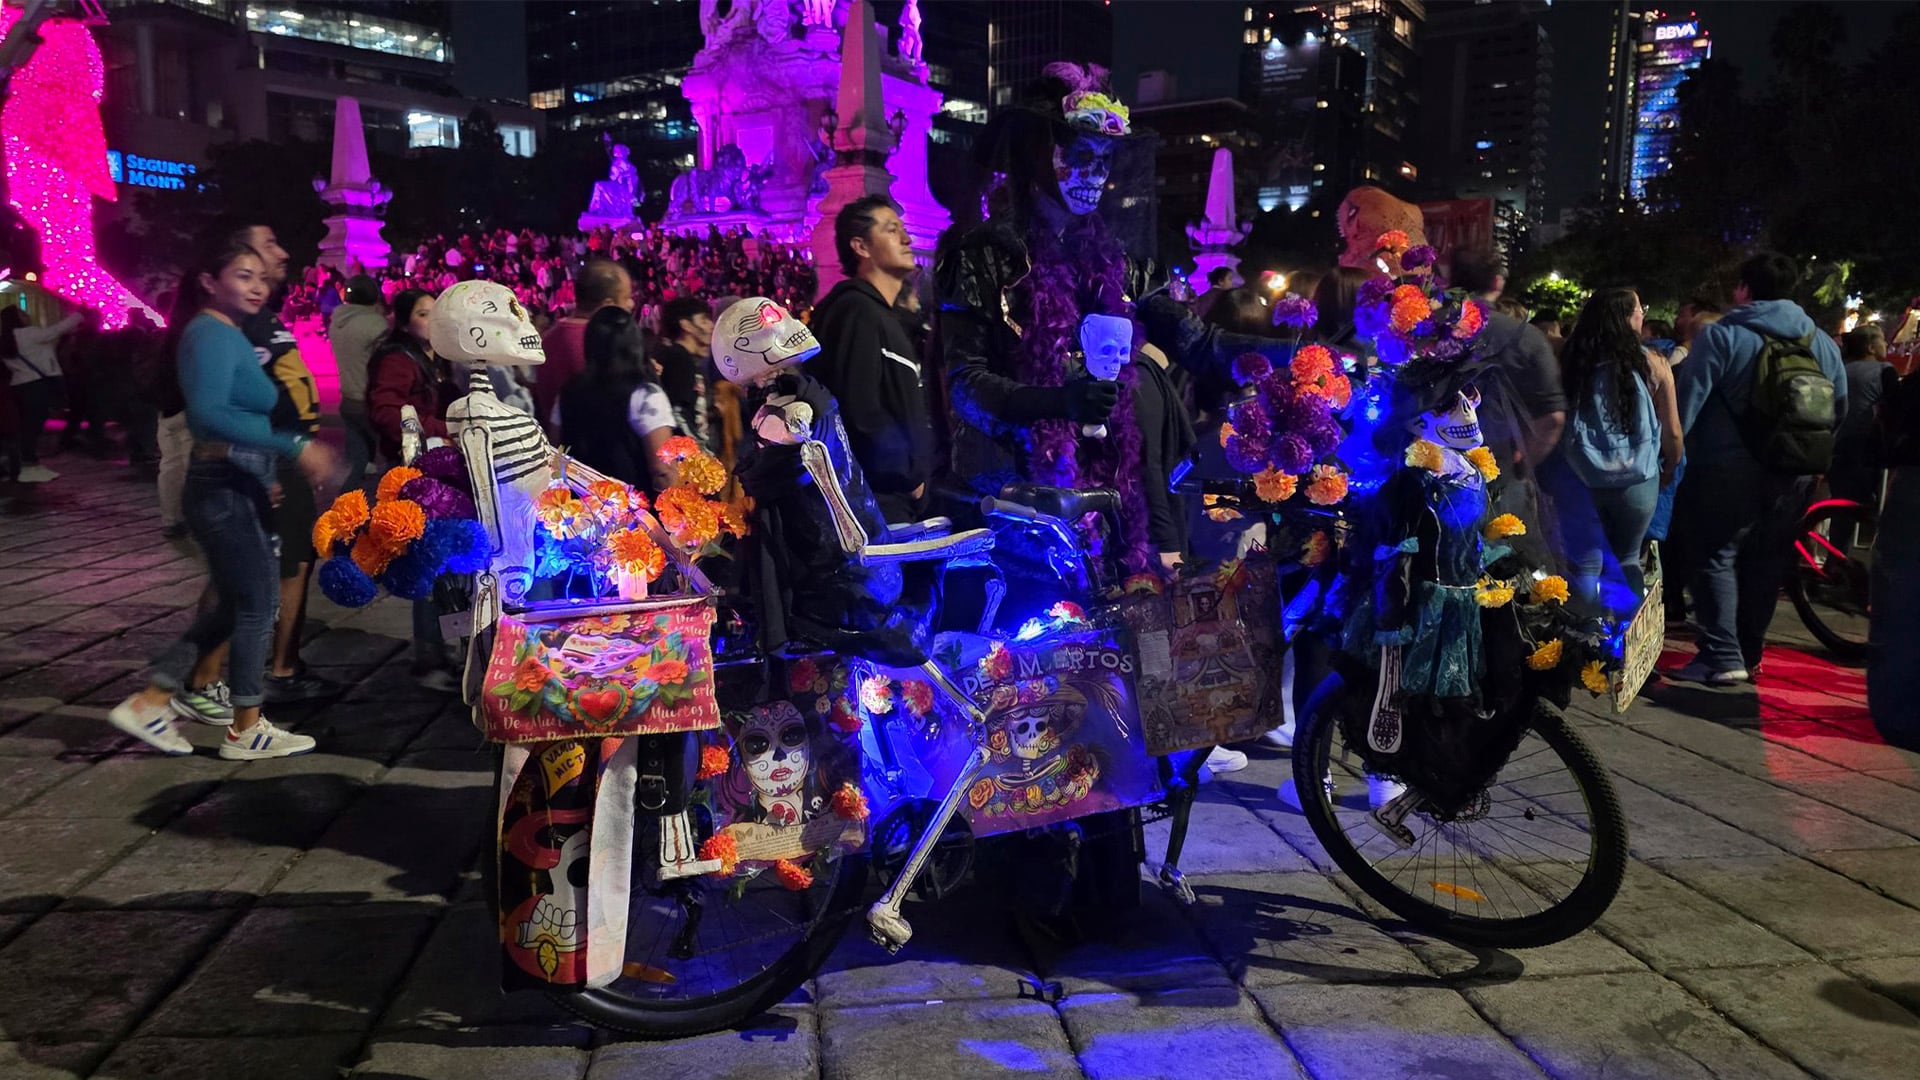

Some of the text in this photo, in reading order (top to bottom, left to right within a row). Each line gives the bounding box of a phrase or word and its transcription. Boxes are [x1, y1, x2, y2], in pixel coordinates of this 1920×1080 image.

[1656, 23, 1696, 40] BBVA
[963, 672, 994, 696] DE
[1018, 650, 1133, 678] MERTOS
